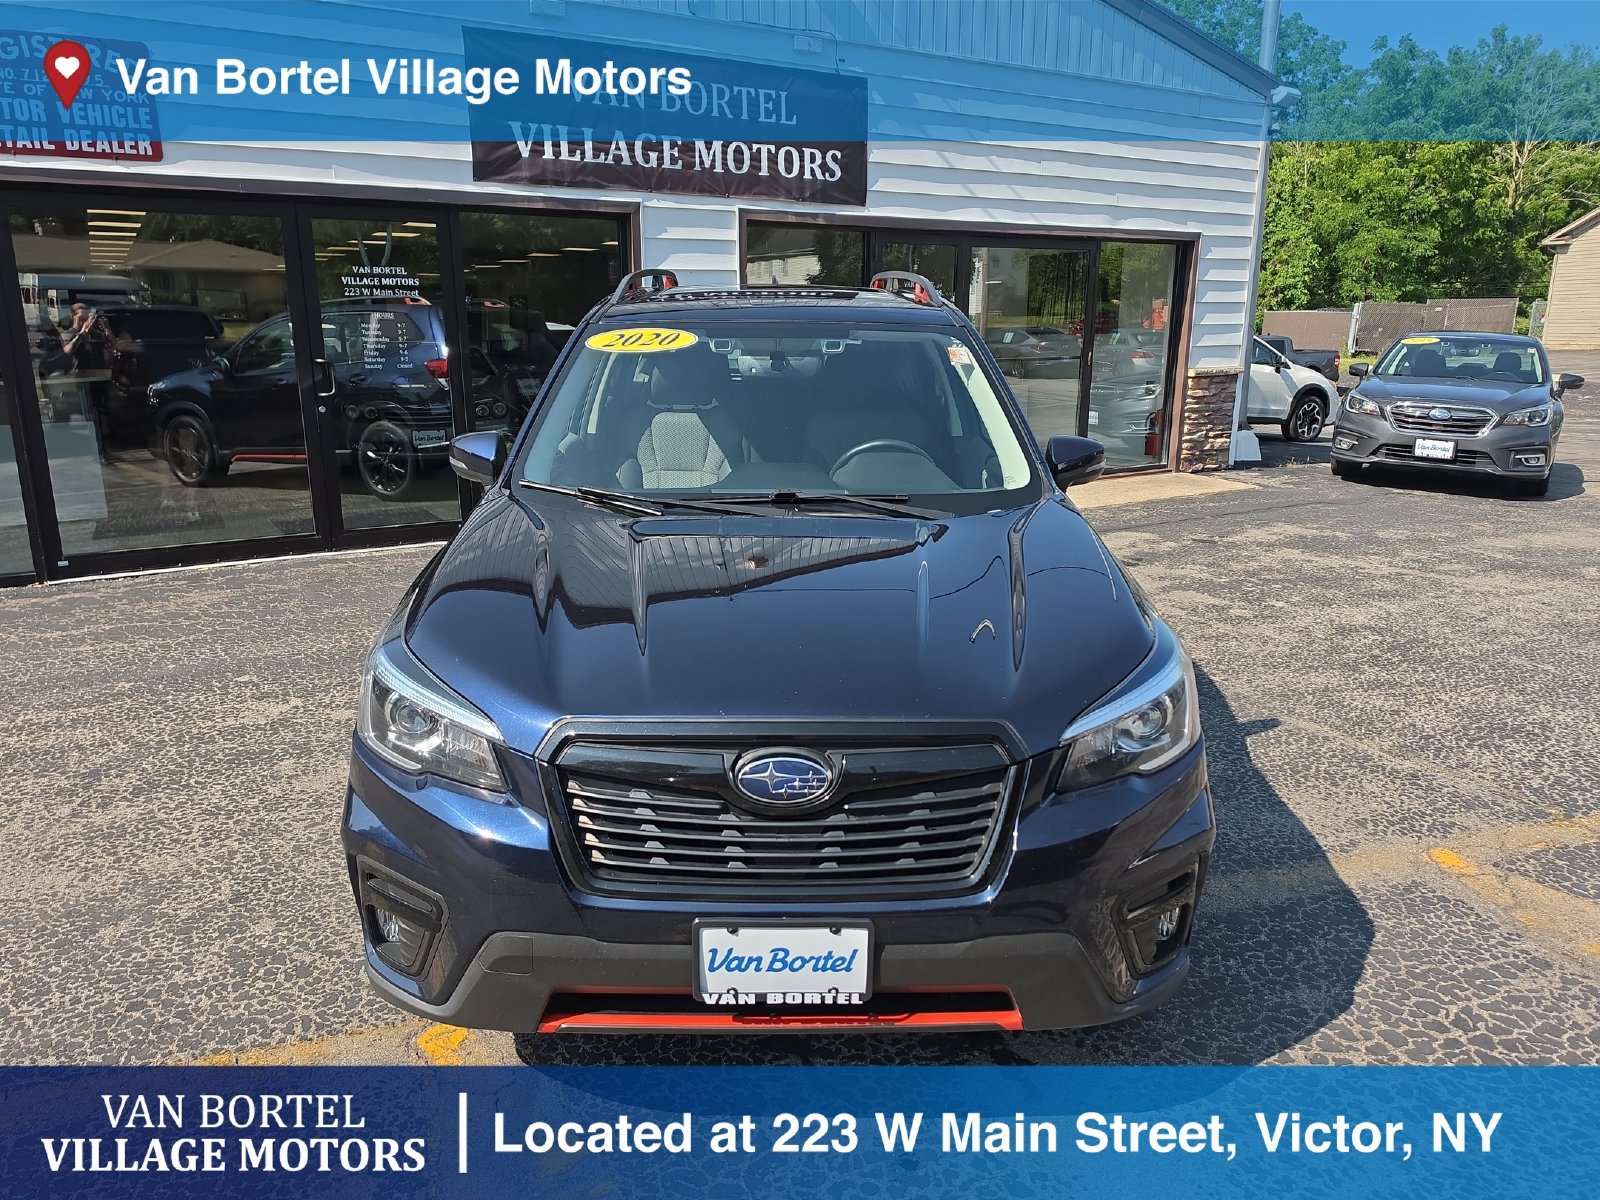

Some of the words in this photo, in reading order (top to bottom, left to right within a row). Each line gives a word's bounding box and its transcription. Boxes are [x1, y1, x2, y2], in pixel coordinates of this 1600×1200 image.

[23, 84, 46, 96] OF
[570, 66, 648, 110] VAN
[659, 77, 797, 125] BORTEL
[56, 101, 153, 129] VEHICLE
[0, 125, 55, 149] TAIL
[64, 129, 153, 155] DEALER
[507, 120, 682, 169] VILLAGE
[694, 138, 842, 182] MOTORS
[352, 266, 371, 274] VAN
[373, 266, 407, 275] BORTEL
[341, 276, 380, 286] VILLAGE
[381, 277, 420, 286] MOTORS
[344, 287, 360, 296] 223
[362, 288, 371, 296] W
[373, 288, 394, 296] Main
[395, 288, 419, 297] Street
[601, 332, 680, 348] 2020
[708, 947, 763, 972] Van
[765, 947, 859, 972] Bortel
[702, 992, 756, 1005] VAN
[766, 992, 863, 1005] BORTEL
